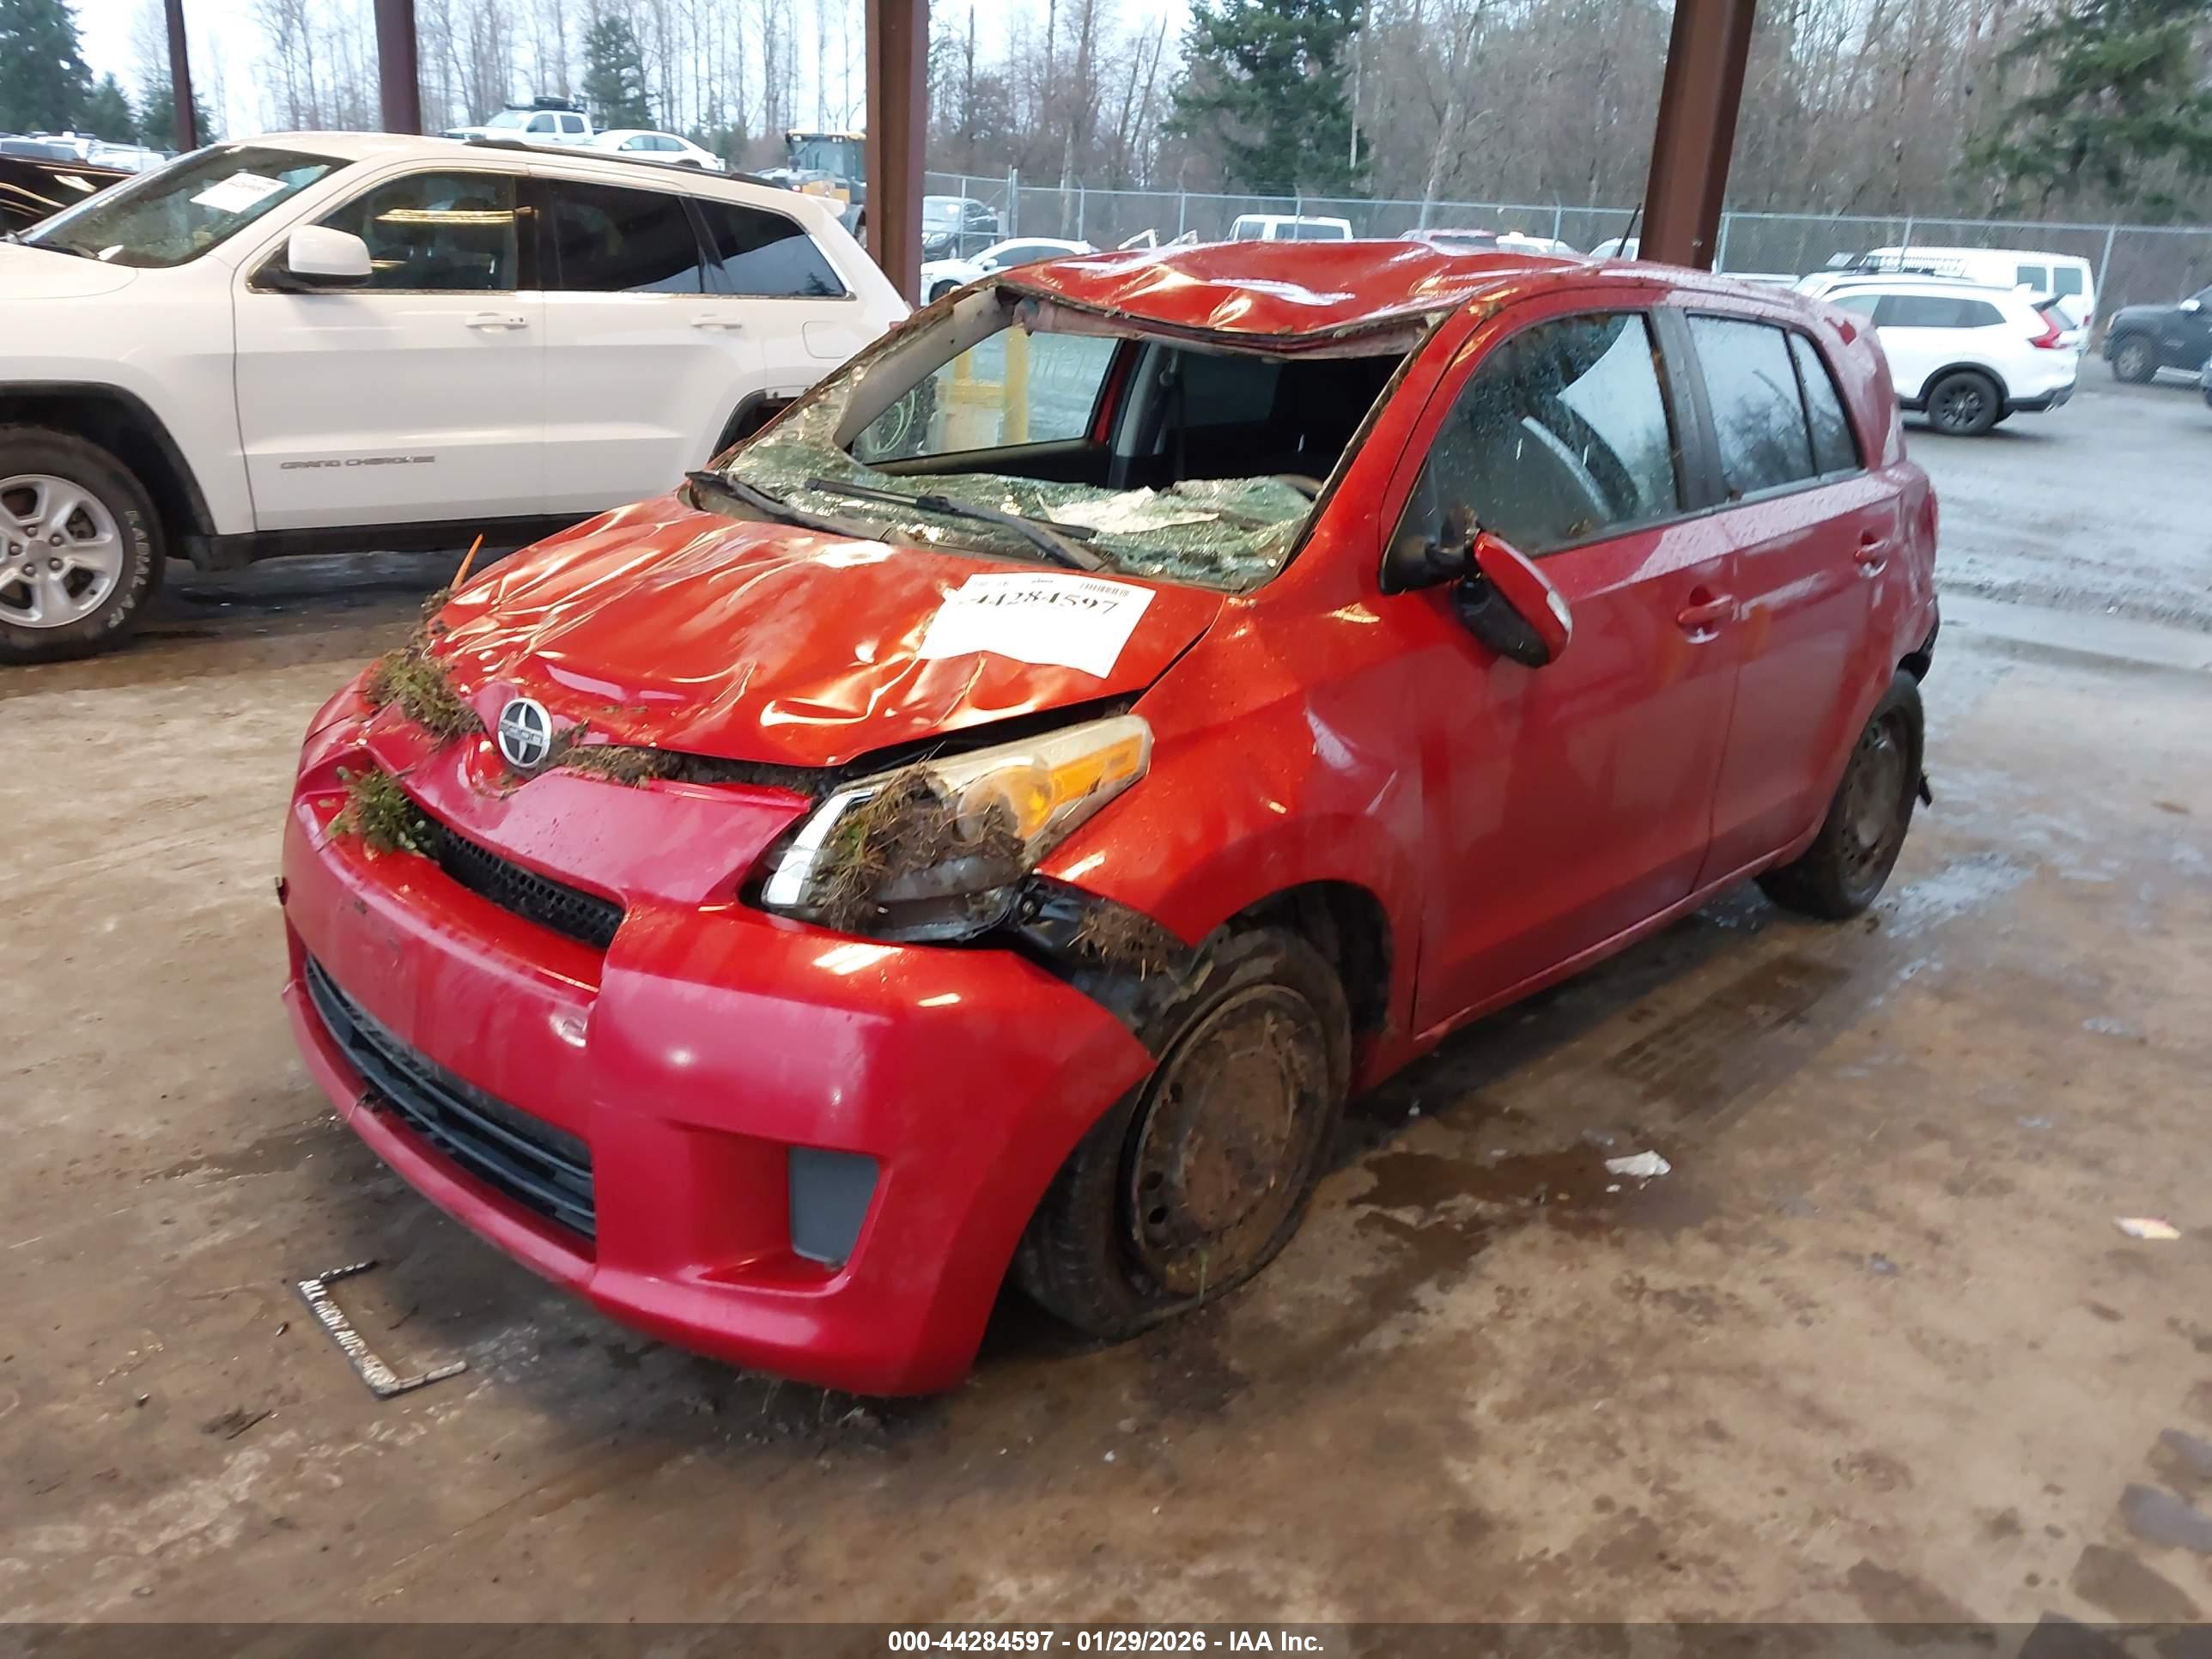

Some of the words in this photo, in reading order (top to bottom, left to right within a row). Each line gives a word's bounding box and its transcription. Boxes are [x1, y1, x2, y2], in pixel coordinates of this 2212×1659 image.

[281, 460, 341, 470] GRAND
[125, 510, 150, 589] RADIAL
[971, 590, 1118, 614] 44284597
